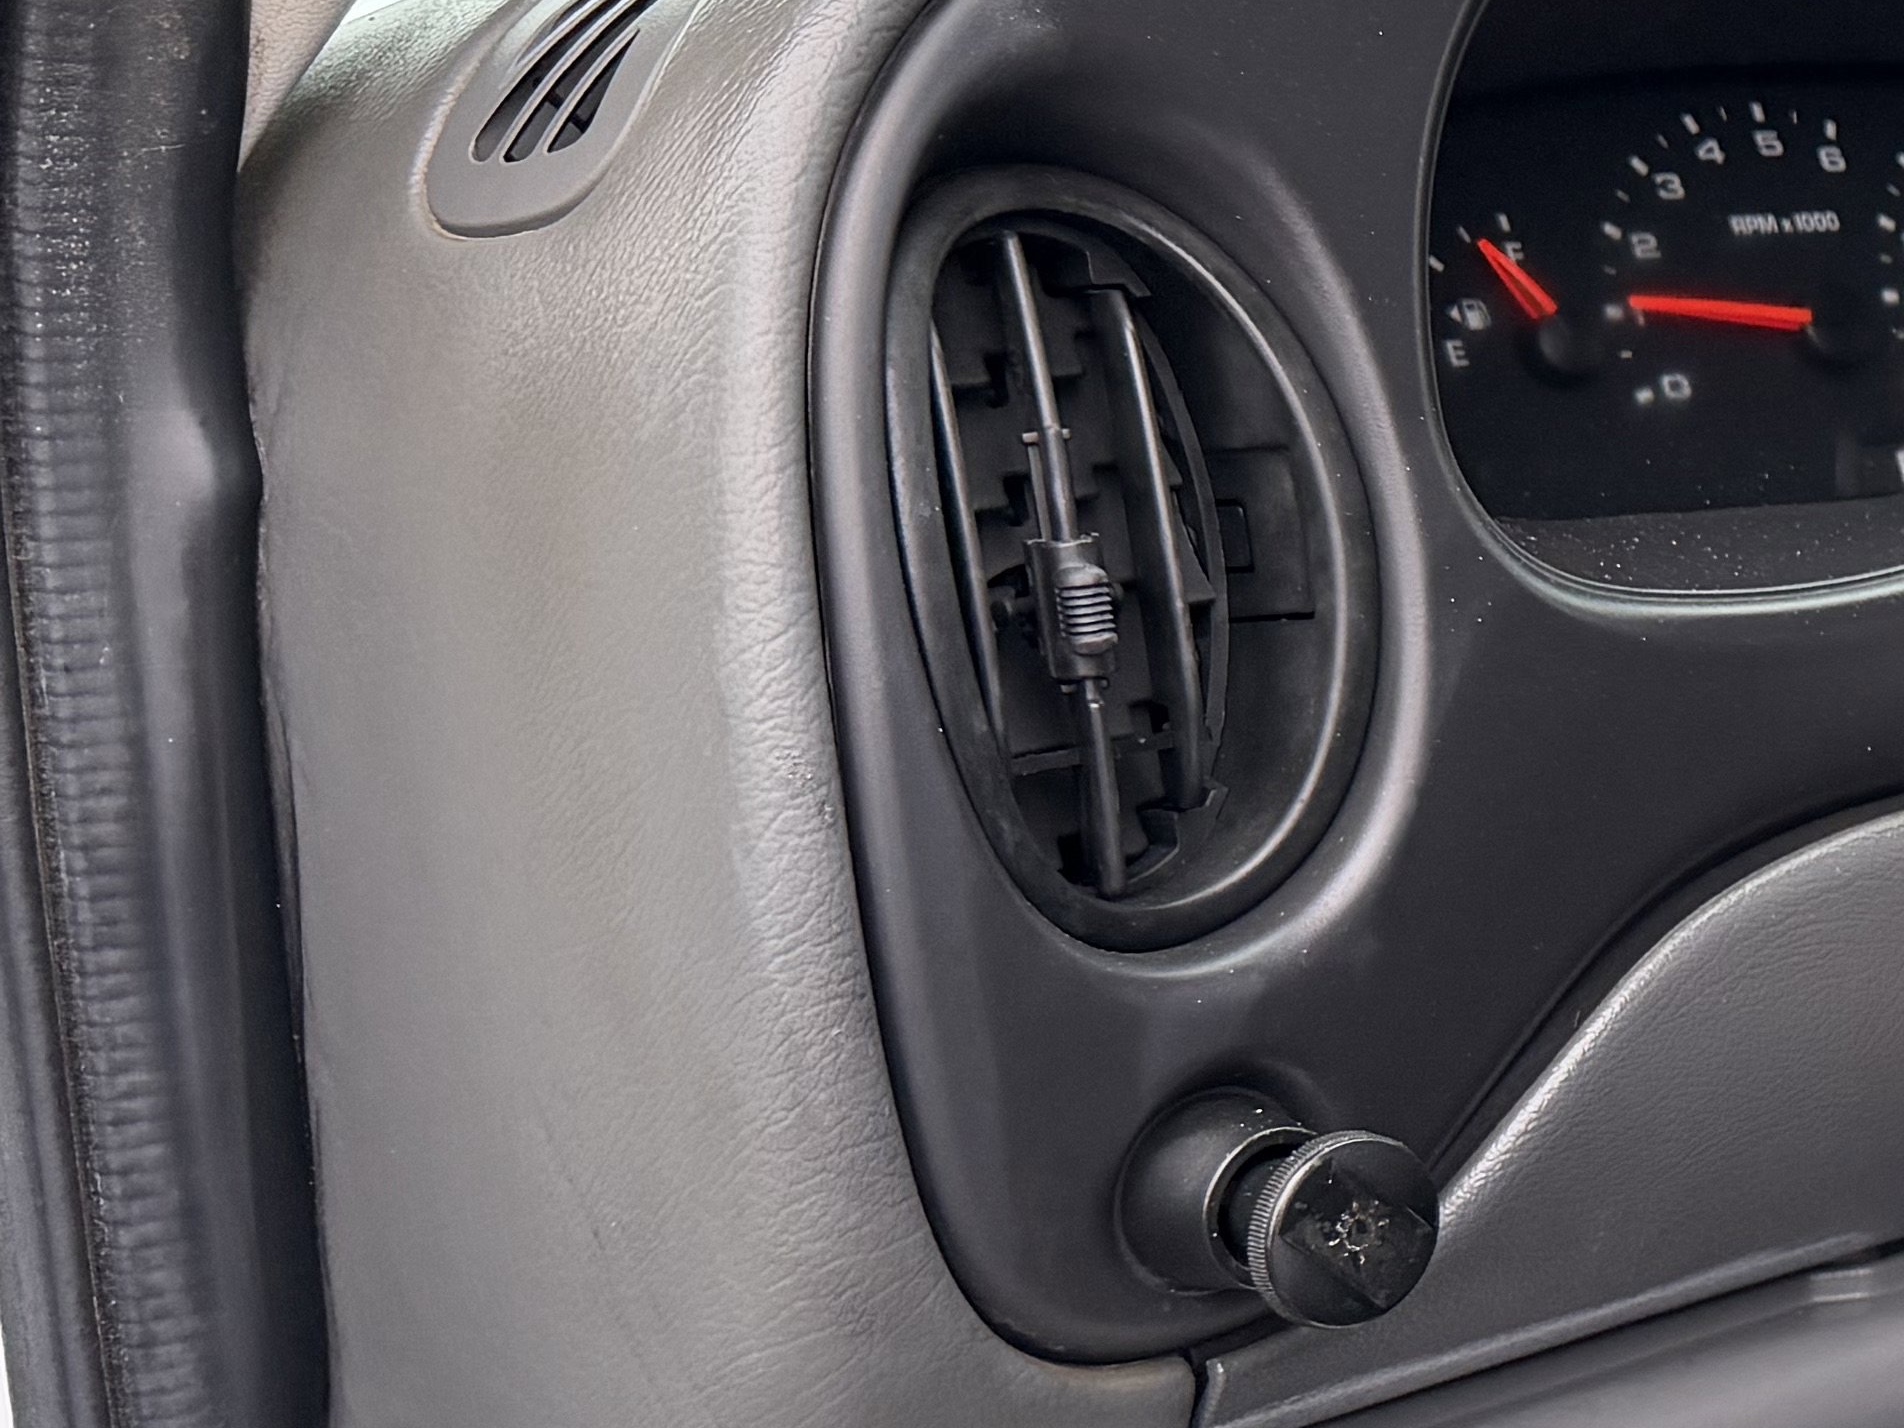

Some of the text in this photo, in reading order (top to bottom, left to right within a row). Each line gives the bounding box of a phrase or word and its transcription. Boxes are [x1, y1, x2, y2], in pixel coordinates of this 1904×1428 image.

[1696, 138, 1726, 164] 4
[1753, 129, 1784, 156] 5
[1817, 145, 1847, 172] 6
[1653, 172, 1685, 200] 3
[1728, 213, 1779, 235] RPM
[1630, 232, 1661, 258] 2
[1446, 340, 1469, 367] E
